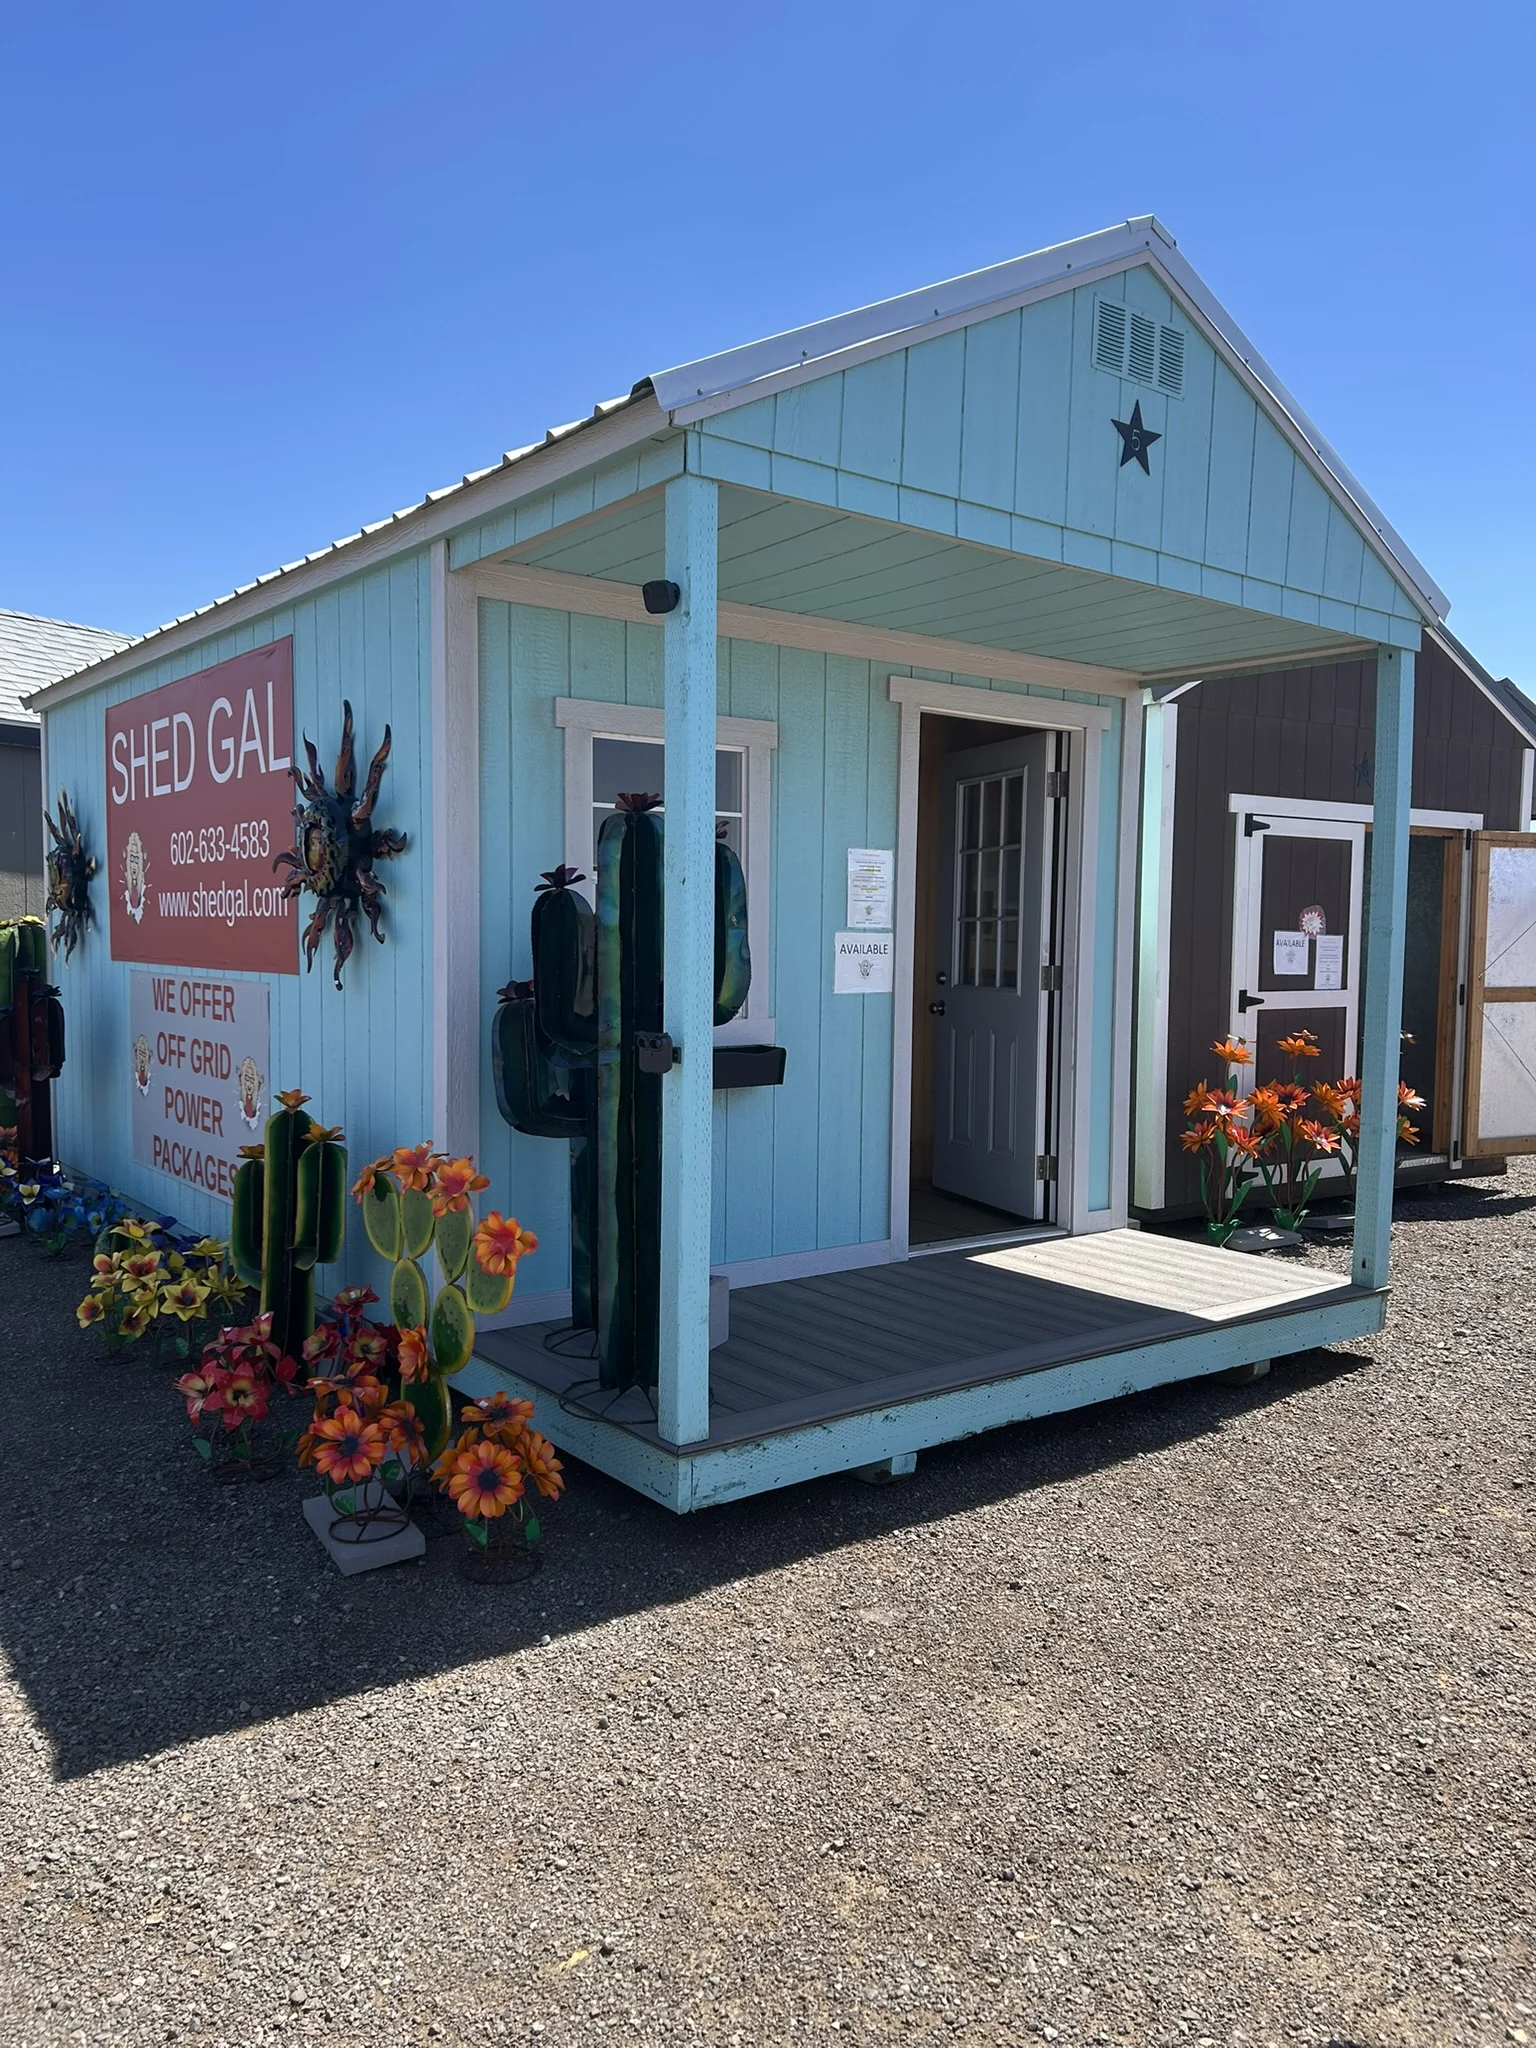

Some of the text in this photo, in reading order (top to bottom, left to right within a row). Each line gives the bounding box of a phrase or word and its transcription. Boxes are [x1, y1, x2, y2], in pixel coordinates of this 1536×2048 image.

[1131, 429, 1141, 451] 5
[111, 681, 291, 805] SHED GAL
[170, 819, 270, 866] 602-633-4583
[158, 878, 289, 927] www.shedgal.com
[840, 944, 889, 955] AVAILABLE
[1276, 939, 1305, 948] AVAILABLE
[152, 977, 235, 1023] WE OFFER
[157, 1031, 231, 1080] OFF GRID
[165, 1086, 224, 1138] POWER
